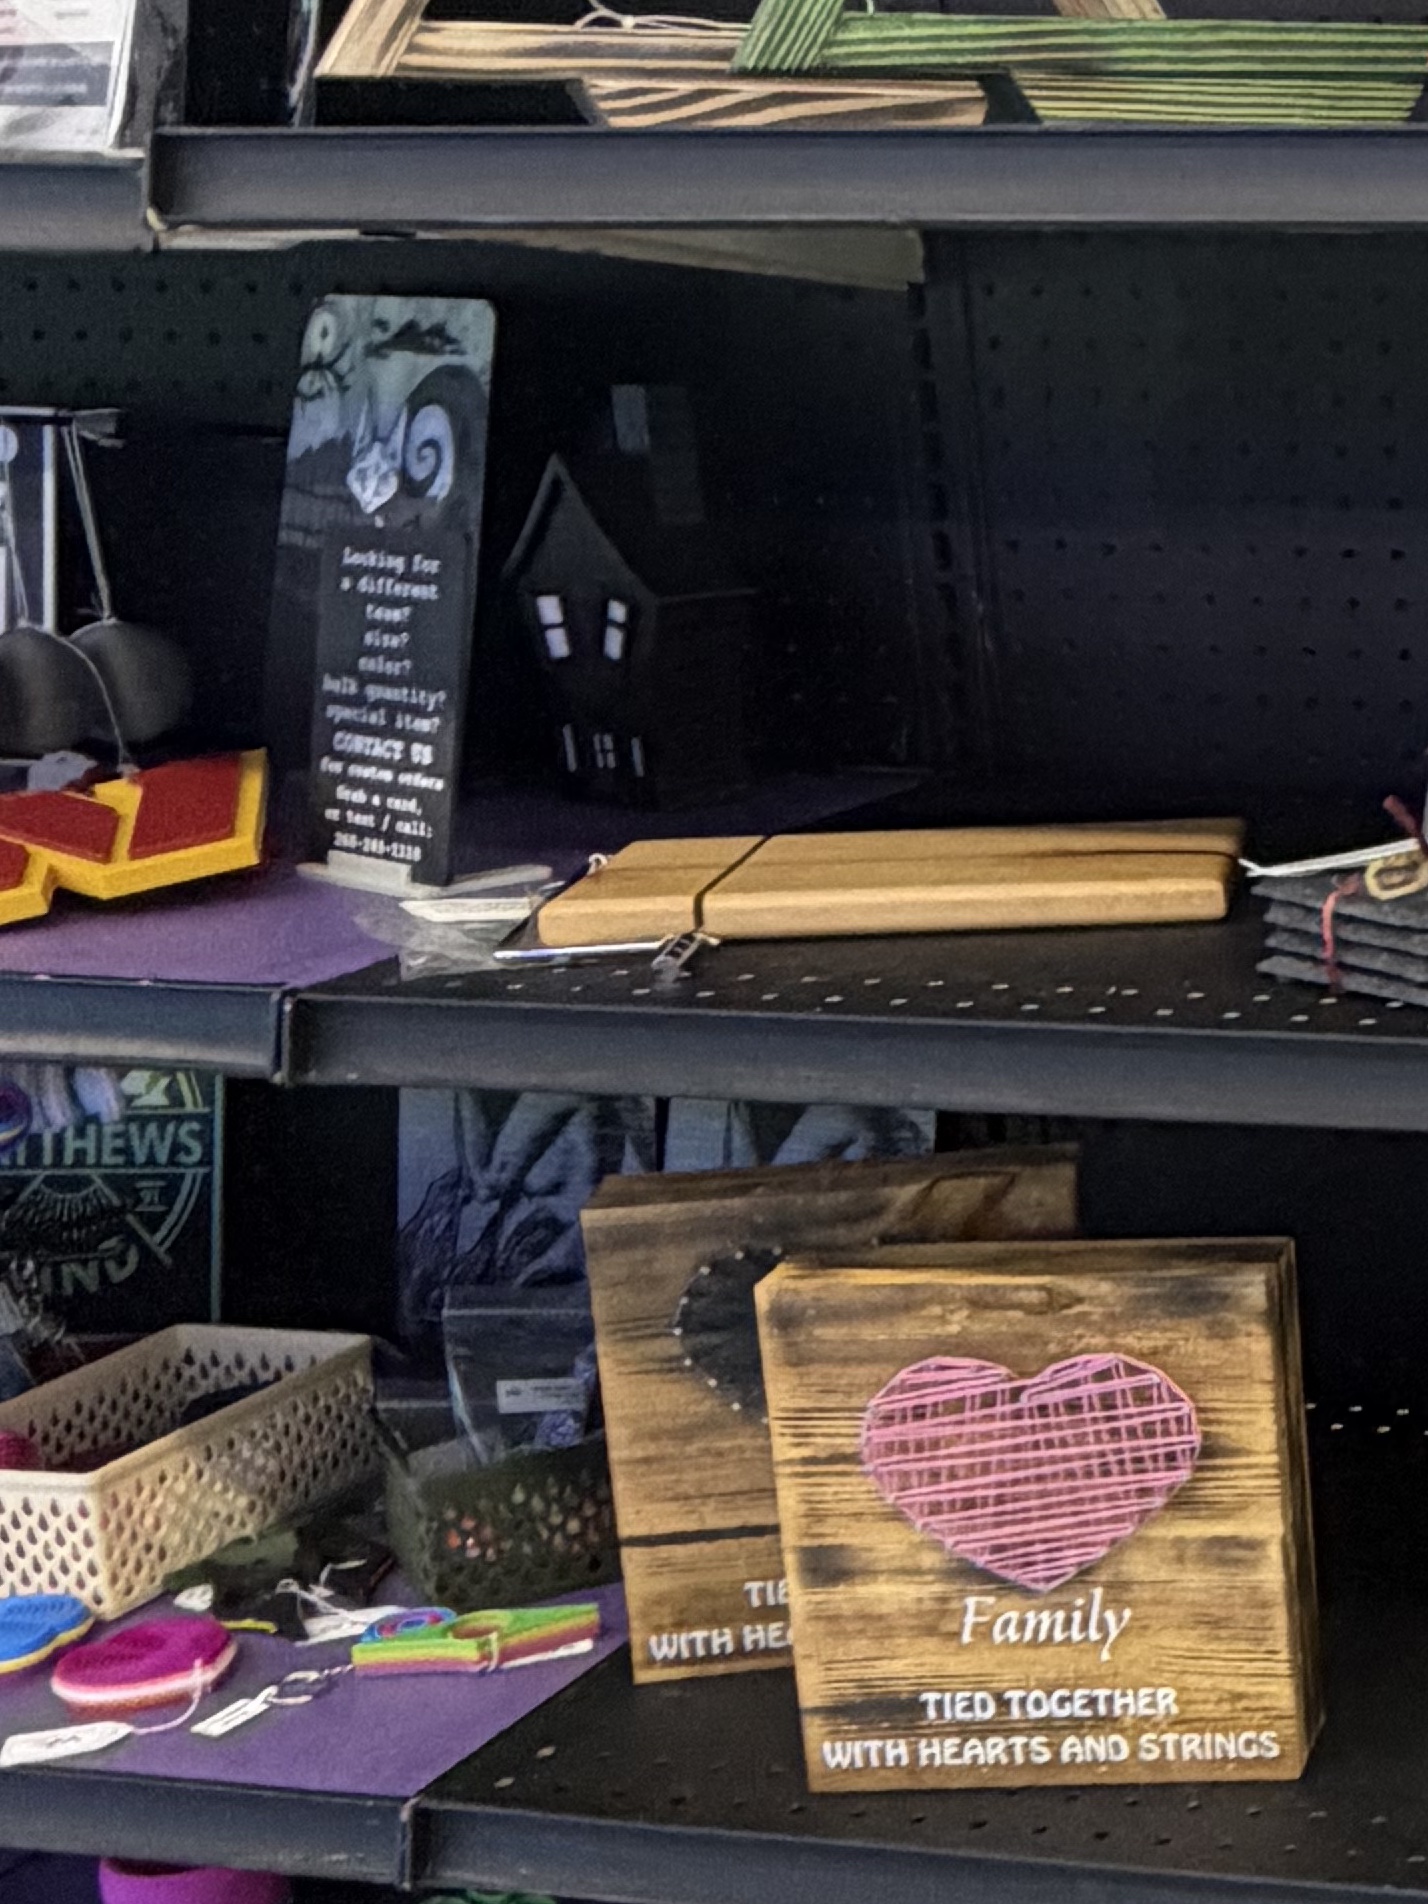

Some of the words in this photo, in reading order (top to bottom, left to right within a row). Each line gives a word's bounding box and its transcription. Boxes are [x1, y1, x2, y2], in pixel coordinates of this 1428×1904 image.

[333, 730, 405, 761] CONTACT
[648, 1627, 734, 1662] WITH
[742, 1620, 793, 1652] HE
[959, 1587, 1133, 1663] Family
[919, 1692, 997, 1722] TIED
[1002, 1687, 1179, 1720] TOGETHER
[822, 1737, 909, 1771] WITH
[917, 1735, 1052, 1769] HEARTS
[1060, 1733, 1131, 1763] AND
[1138, 1730, 1281, 1761] STRINGS
